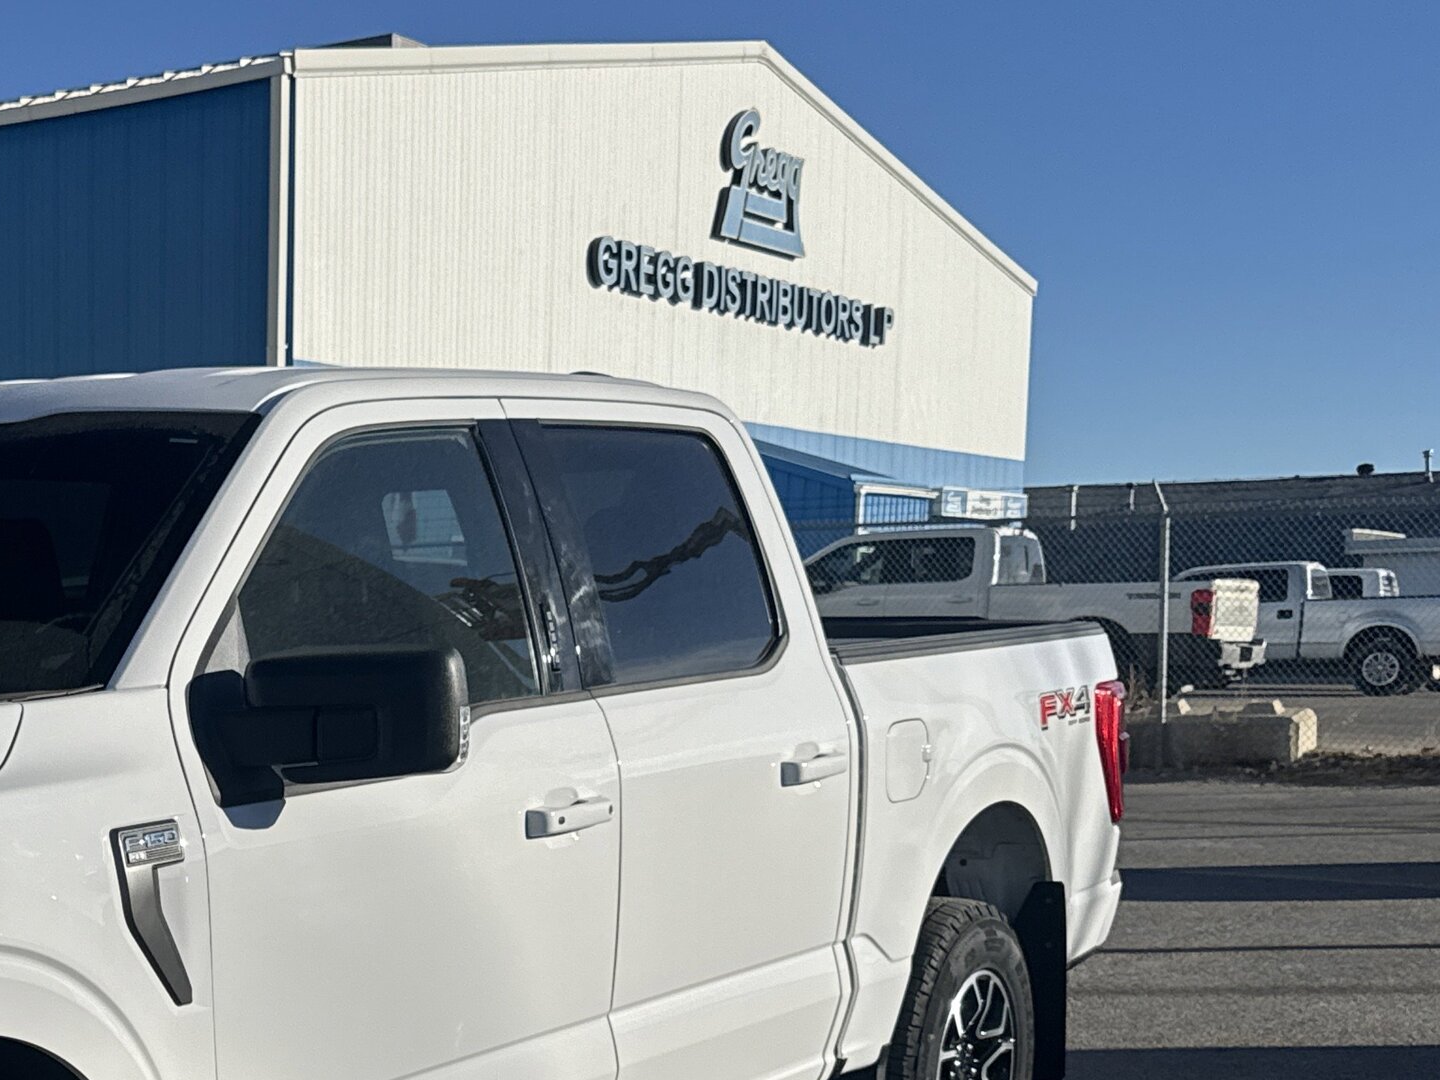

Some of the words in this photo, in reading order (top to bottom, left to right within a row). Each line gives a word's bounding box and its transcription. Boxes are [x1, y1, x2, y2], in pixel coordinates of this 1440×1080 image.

[720, 107, 805, 201] Gregg
[592, 236, 696, 304] GREGG
[701, 260, 864, 342] DISTRIBUTORS
[1039, 685, 1091, 731] FX4
[125, 828, 178, 852] F-150
